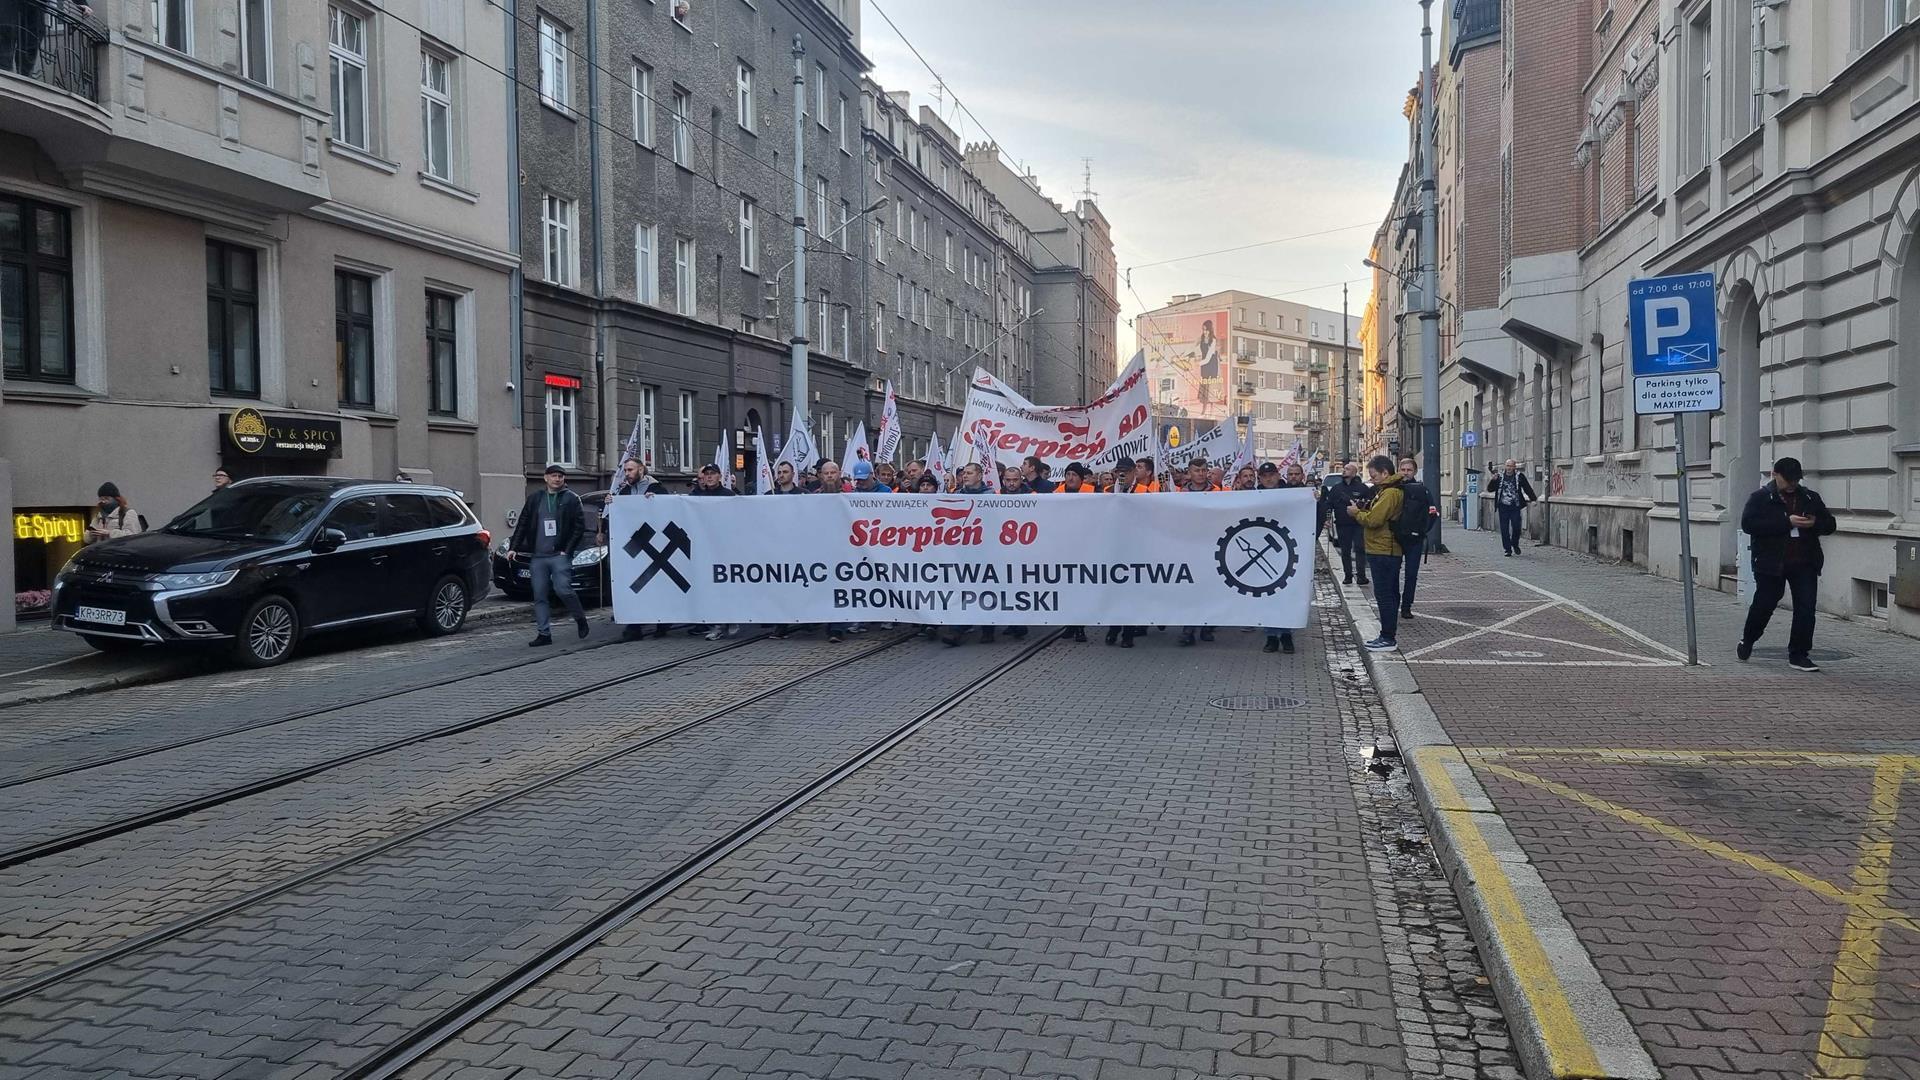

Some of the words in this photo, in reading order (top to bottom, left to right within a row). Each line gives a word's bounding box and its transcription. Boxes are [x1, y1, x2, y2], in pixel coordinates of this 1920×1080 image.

[1633, 287, 1643, 295] od
[1648, 285, 1667, 294] 7:00
[1672, 282, 1684, 291] do
[1688, 280, 1712, 289] 17:00
[1644, 296, 1691, 356] P
[1646, 379, 1681, 389] Parking
[1685, 378, 1709, 387] tylko
[1641, 390, 1657, 399] dla
[1660, 388, 1714, 398] dostawców
[972, 398, 994, 411] Wolny
[995, 403, 1024, 418] Związek
[1026, 411, 1059, 425] Zawodowy
[1653, 400, 1702, 409] MAXIPIZZY
[289, 429, 297, 440] &
[303, 430, 336, 441] SPICY
[964, 418, 1107, 460] Sierpień
[1118, 405, 1148, 440] 80
[276, 442, 305, 450] restauracja
[305, 443, 326, 451] indyjska
[850, 500, 883, 508] WOLNY
[885, 499, 929, 509] ZWIĄZEK
[977, 500, 1038, 508] ZAWODOWY
[33, 515, 78, 543] Spicy
[849, 518, 983, 552] Sierpień
[999, 520, 1038, 545] 80
[712, 562, 828, 588] BRONIĄC
[835, 557, 1000, 584] GÓRNICTWA
[1006, 564, 1013, 583] I
[1021, 563, 1194, 584] HUTNICTWA
[833, 588, 954, 611] BRONIMY
[961, 590, 1059, 611] POLSKI
